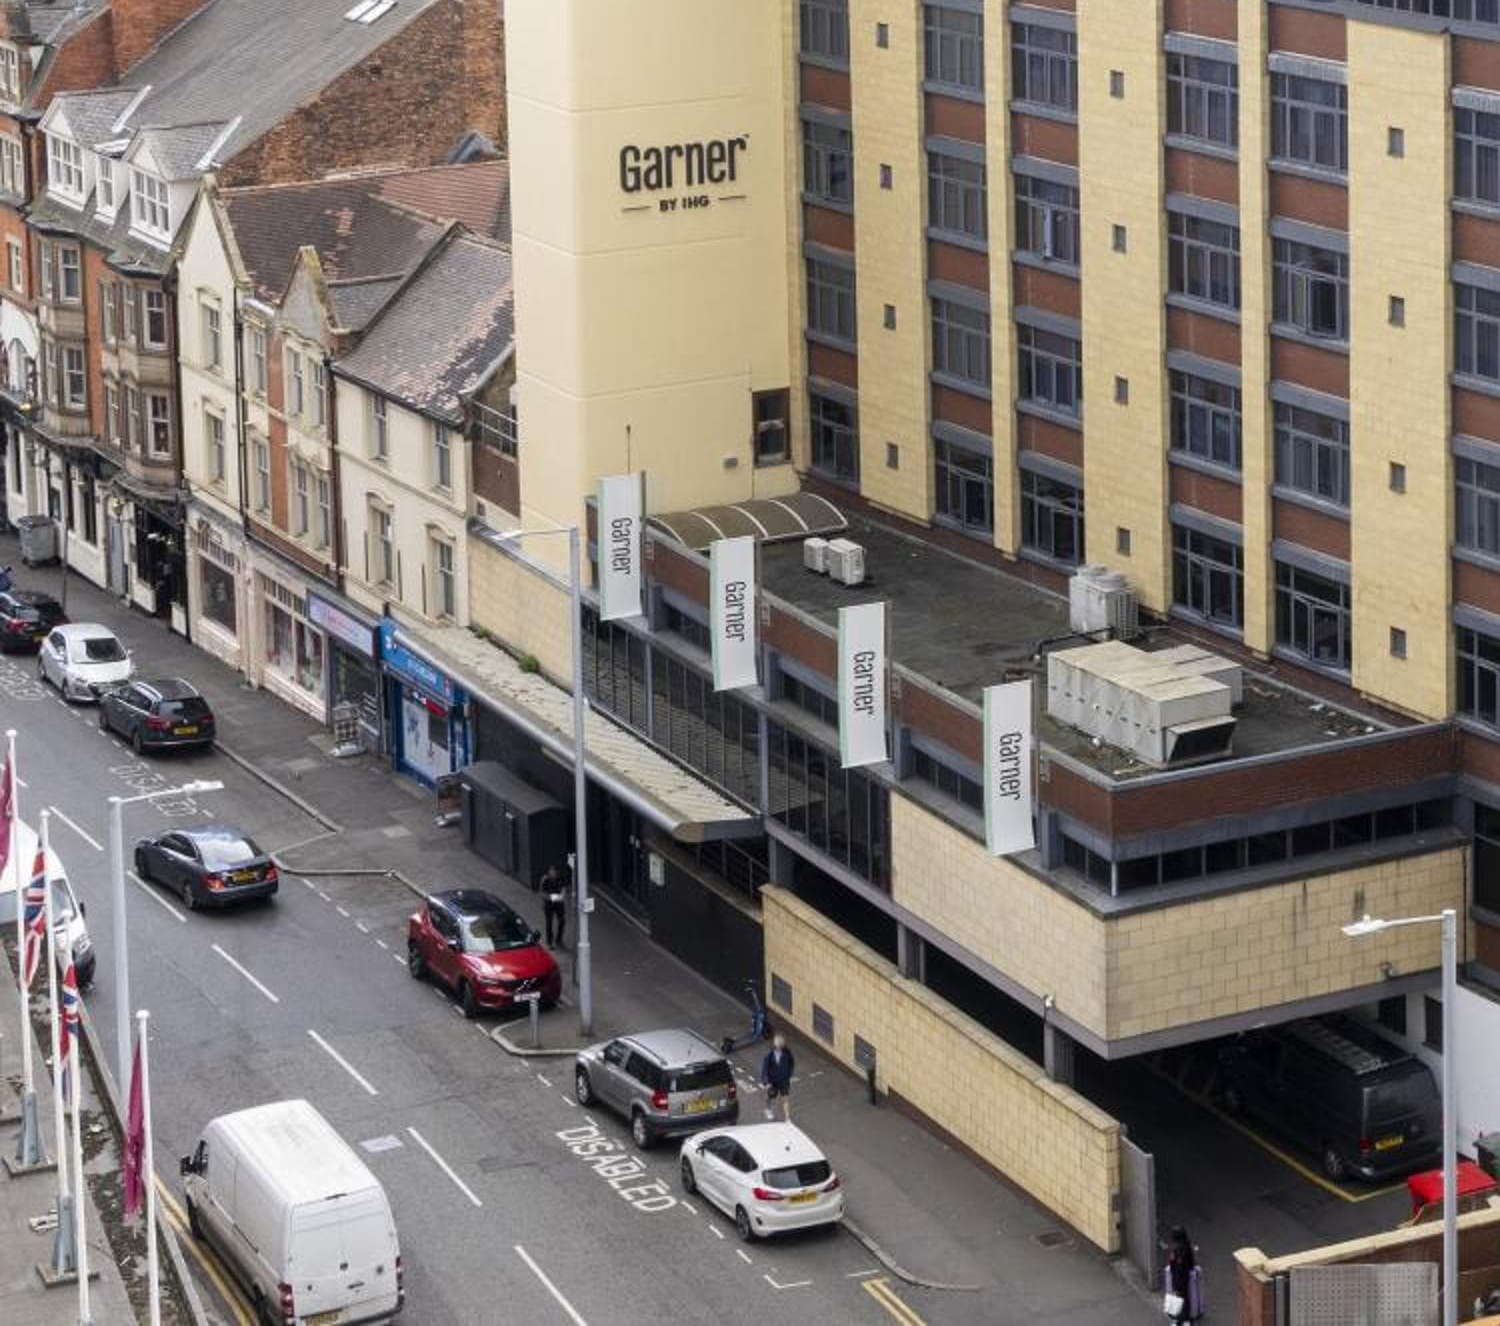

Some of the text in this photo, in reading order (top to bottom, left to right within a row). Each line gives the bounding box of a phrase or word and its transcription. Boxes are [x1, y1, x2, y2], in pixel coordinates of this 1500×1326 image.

[620, 137, 747, 193] Garner
[659, 195, 710, 212] BY IHG
[611, 516, 633, 575] Garner
[725, 581, 747, 642] Garner
[853, 651, 876, 715] Garner
[999, 731, 1023, 801] Garner
[556, 1126, 677, 1211] DISABLED
